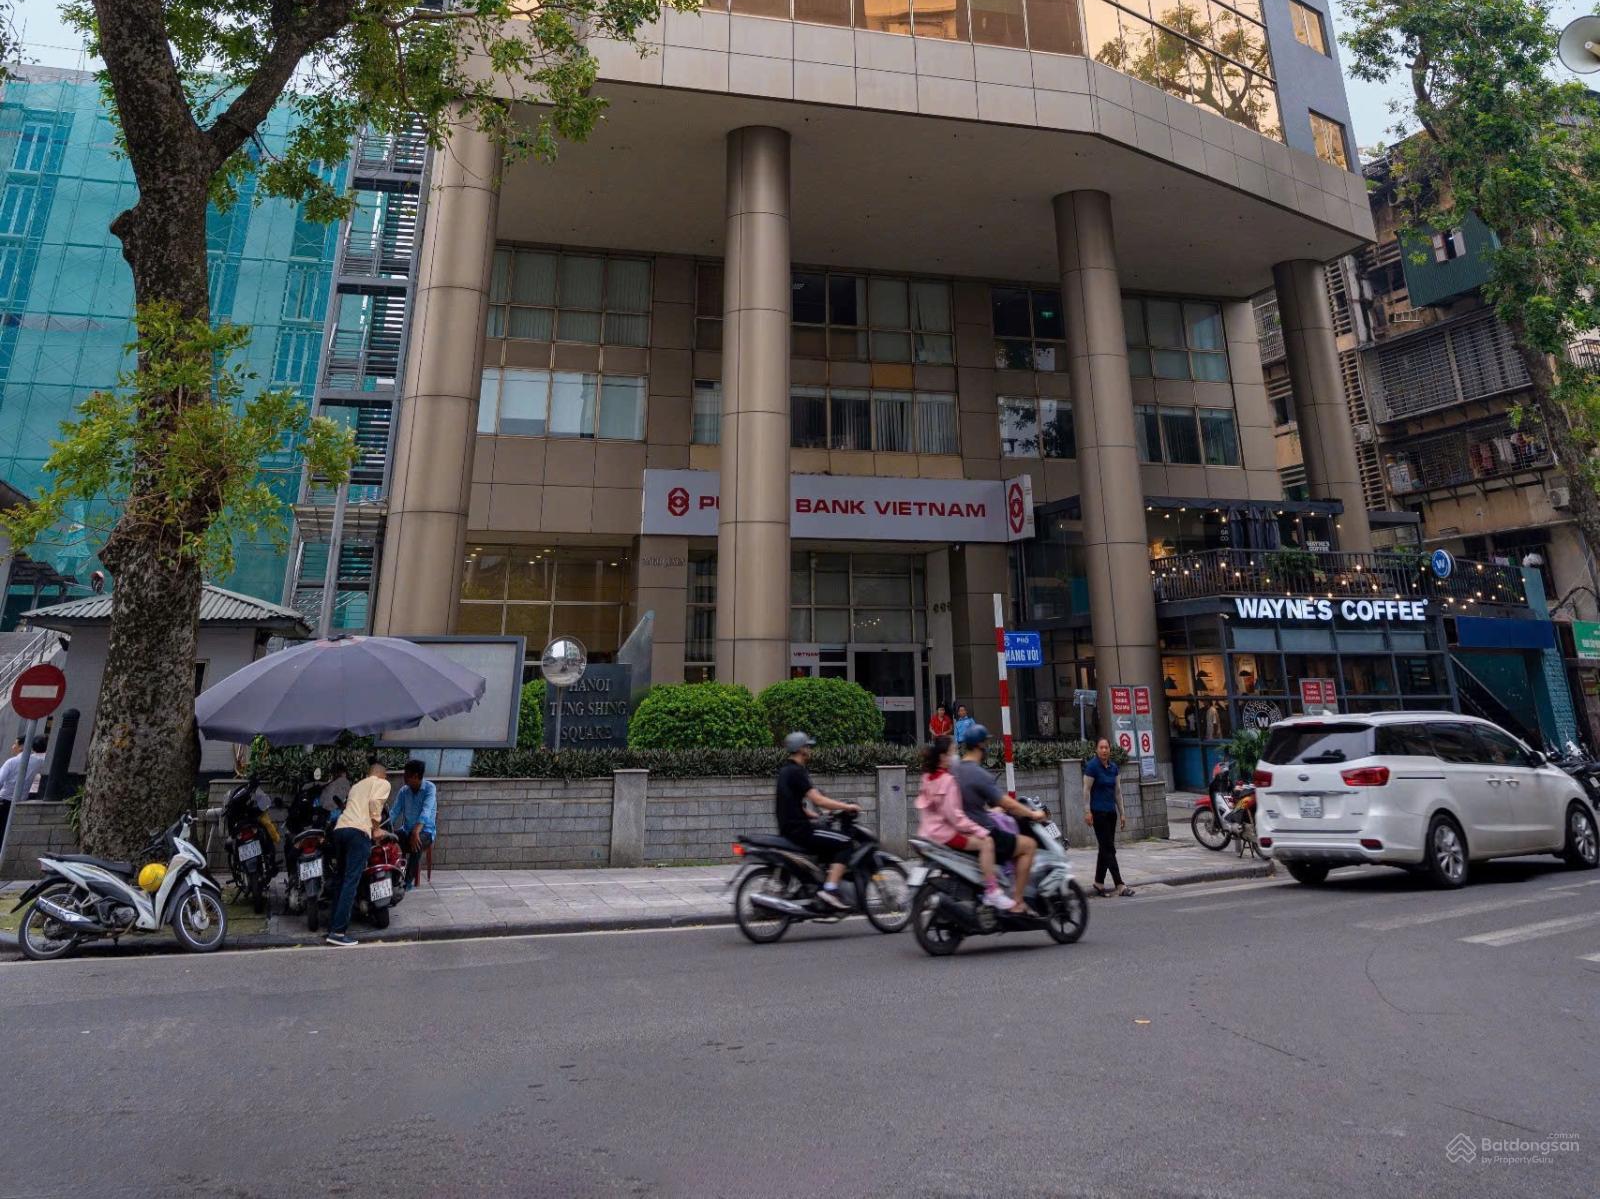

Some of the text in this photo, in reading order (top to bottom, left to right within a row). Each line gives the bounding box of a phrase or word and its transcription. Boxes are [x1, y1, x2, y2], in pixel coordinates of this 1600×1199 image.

[795, 498, 866, 514] BANK
[875, 500, 986, 518] VIETNAM
[1234, 597, 1426, 621] WAYNE'S COFFEE
[569, 678, 610, 692] HANOI
[588, 701, 627, 716] SHING
[1256, 716, 1269, 728] W
[561, 725, 613, 742] SQUARE
